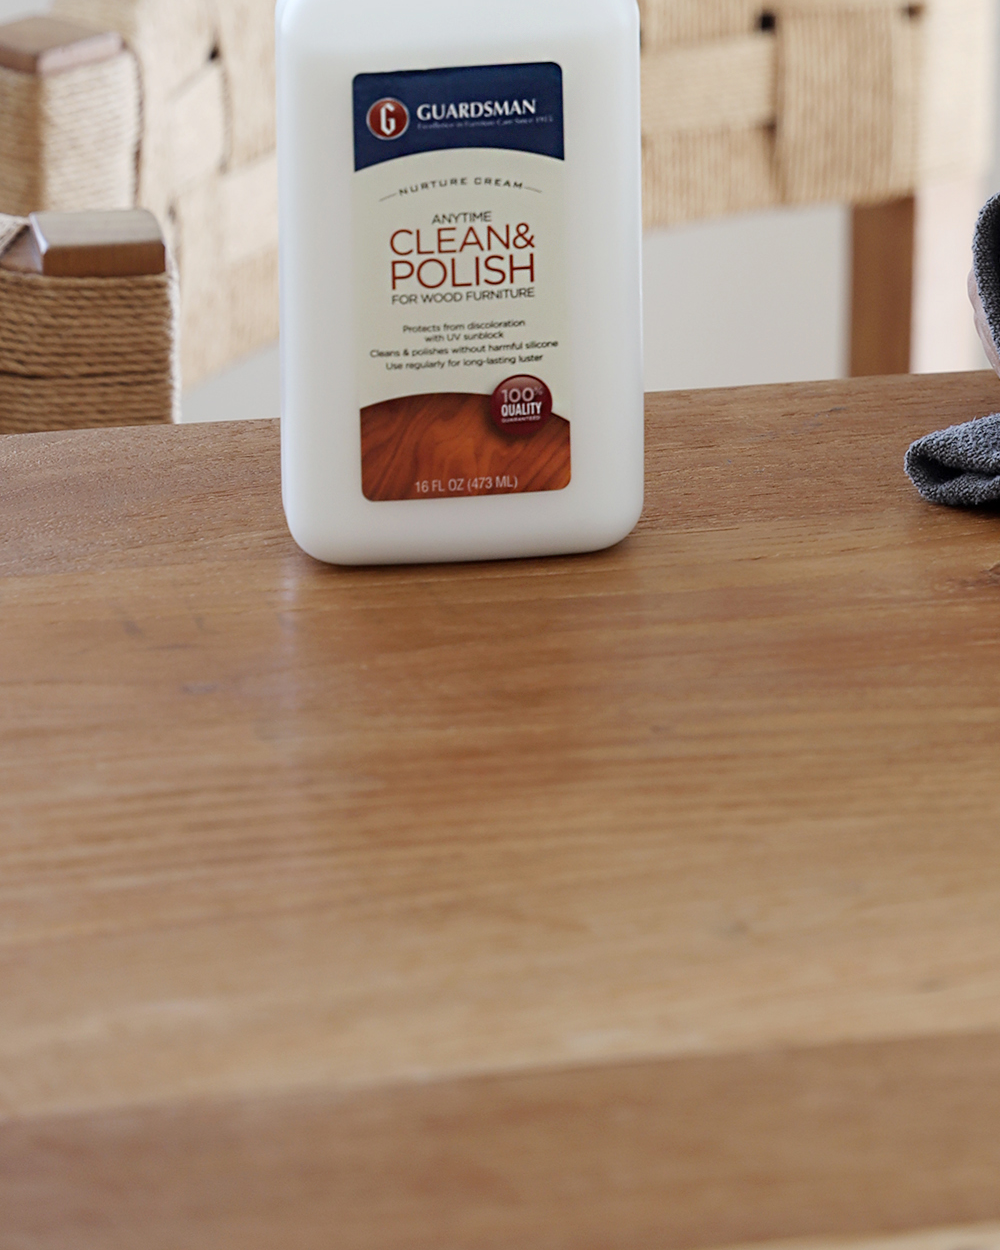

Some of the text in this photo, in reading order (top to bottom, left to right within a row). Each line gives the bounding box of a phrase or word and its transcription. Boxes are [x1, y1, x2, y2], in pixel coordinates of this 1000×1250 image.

[416, 98, 536, 121] GUARDSMAN
[399, 177, 523, 196] NURTURE CREAM
[431, 211, 492, 225] ANYTIME
[390, 222, 535, 256] CLEAN&
[391, 252, 535, 290] POLISH
[392, 287, 535, 305] FOR WOOD FURNITURE
[402, 319, 525, 333] Protects from discoloration
[425, 330, 504, 342] with UV sunblock
[369, 339, 559, 358] Cleans & polishes without harmful silicone
[385, 353, 543, 370] Use regularly for long-lasting luster
[501, 401, 542, 417] QUALITY
[415, 474, 518, 493] 16 FL OZ (473 ML)
